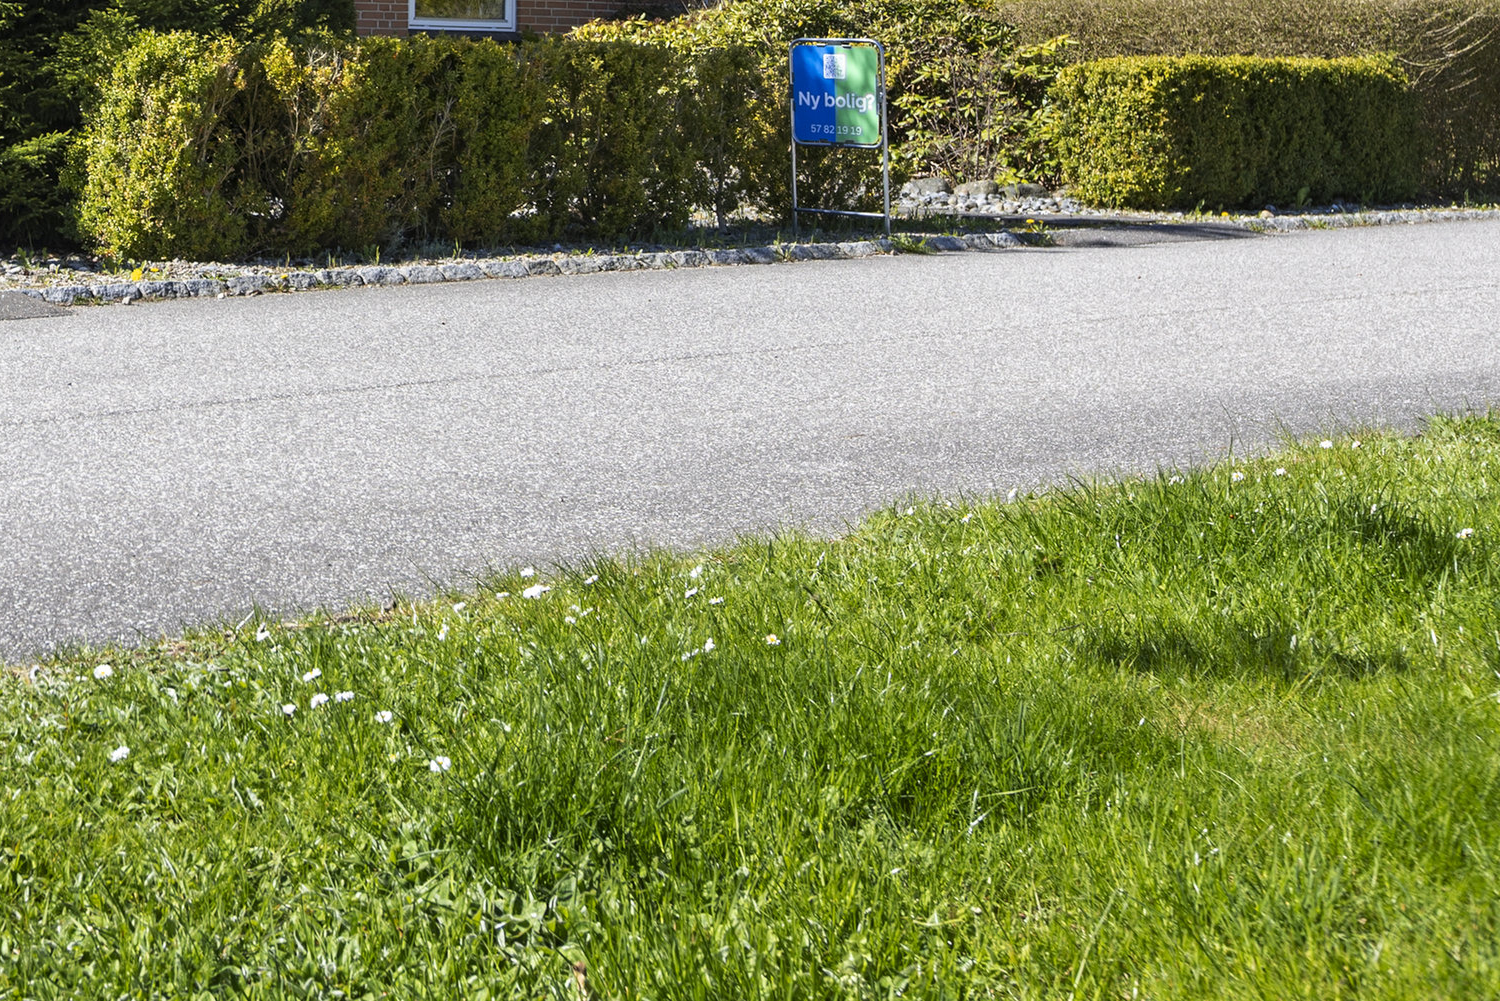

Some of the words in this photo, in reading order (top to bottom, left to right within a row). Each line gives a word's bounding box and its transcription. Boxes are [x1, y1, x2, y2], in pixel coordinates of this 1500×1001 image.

[798, 90, 821, 110] Ny
[824, 91, 875, 113] bolig?
[810, 123, 822, 133] 57
[823, 124, 835, 134] 82
[837, 125, 849, 135] 19
[850, 126, 862, 136] 19
